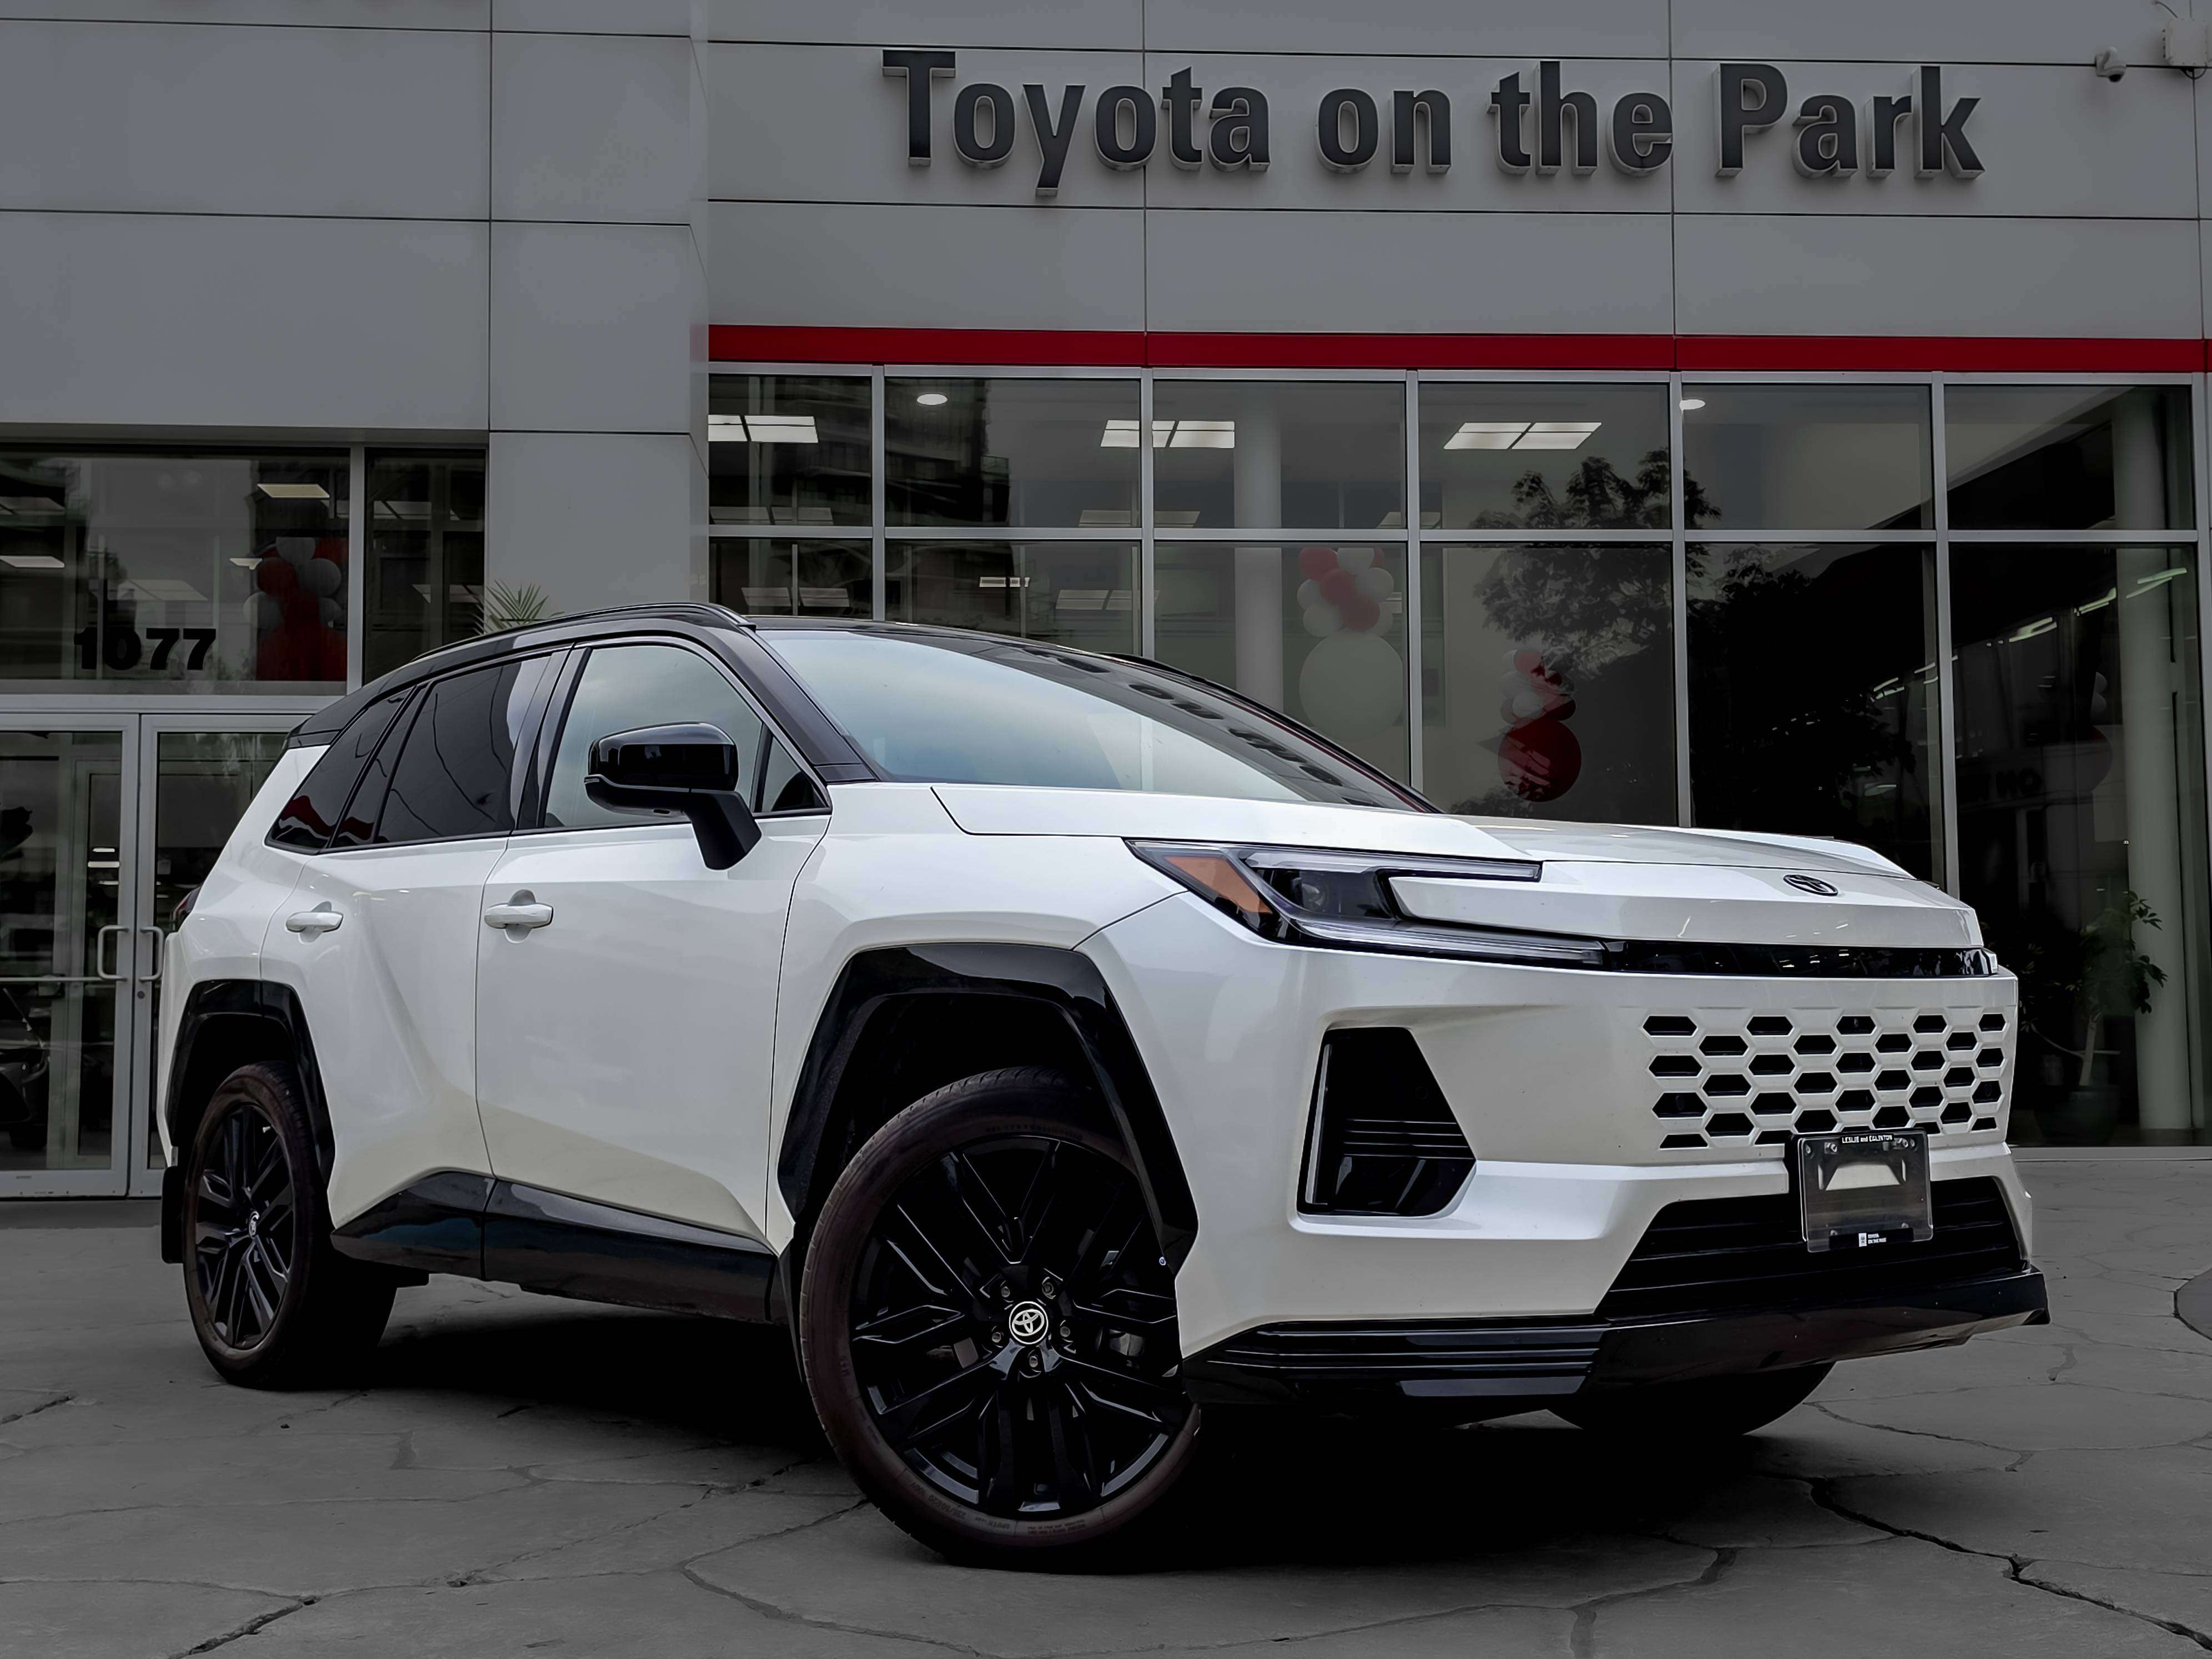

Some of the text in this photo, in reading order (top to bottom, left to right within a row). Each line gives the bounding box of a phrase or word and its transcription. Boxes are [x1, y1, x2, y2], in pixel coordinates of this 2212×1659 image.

[883, 49, 1986, 196] Toyota on the Park
[74, 627, 216, 670] 1077
